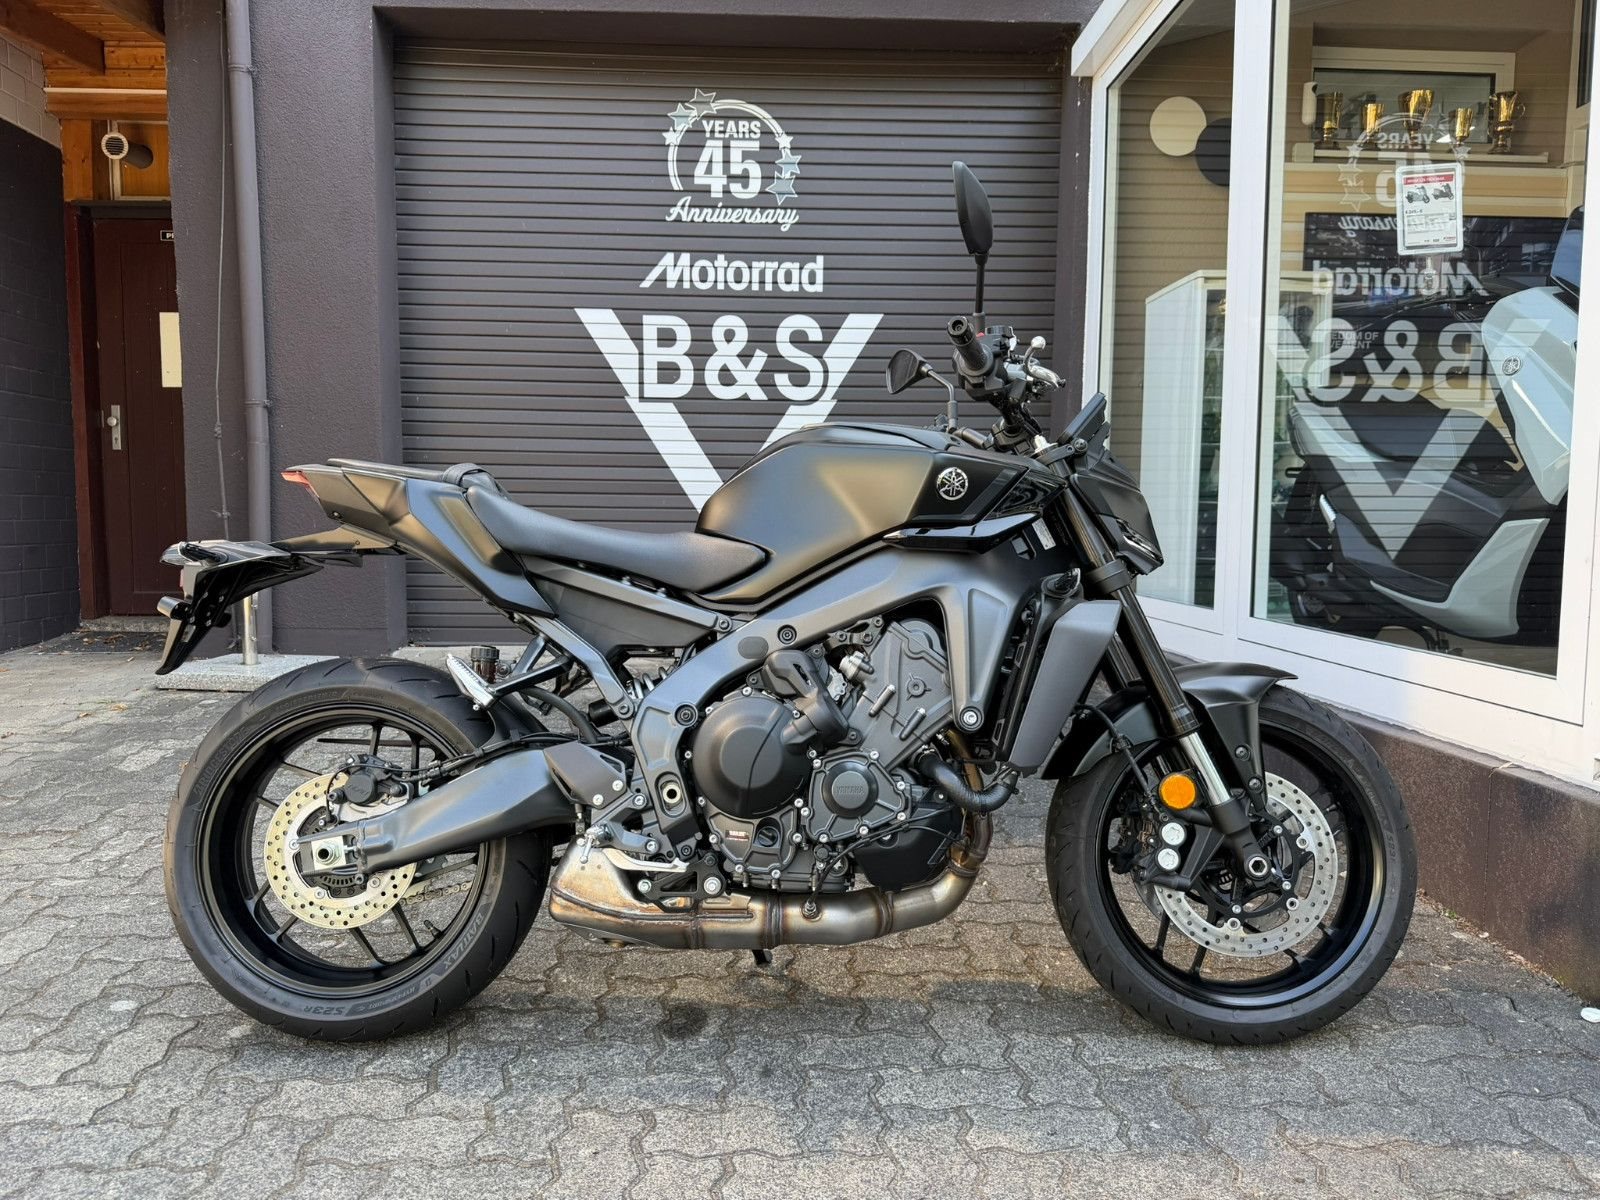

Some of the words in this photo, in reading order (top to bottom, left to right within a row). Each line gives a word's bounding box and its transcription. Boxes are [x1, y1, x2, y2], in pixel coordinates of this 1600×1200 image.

[702, 119, 761, 139] YEARS
[693, 139, 762, 199] 45
[665, 195, 800, 231] Anniversary
[639, 252, 825, 293] Motorrad
[1364, 331, 1379, 341] OF
[642, 314, 826, 401] B&S
[444, 912, 484, 970] BATTLAX
